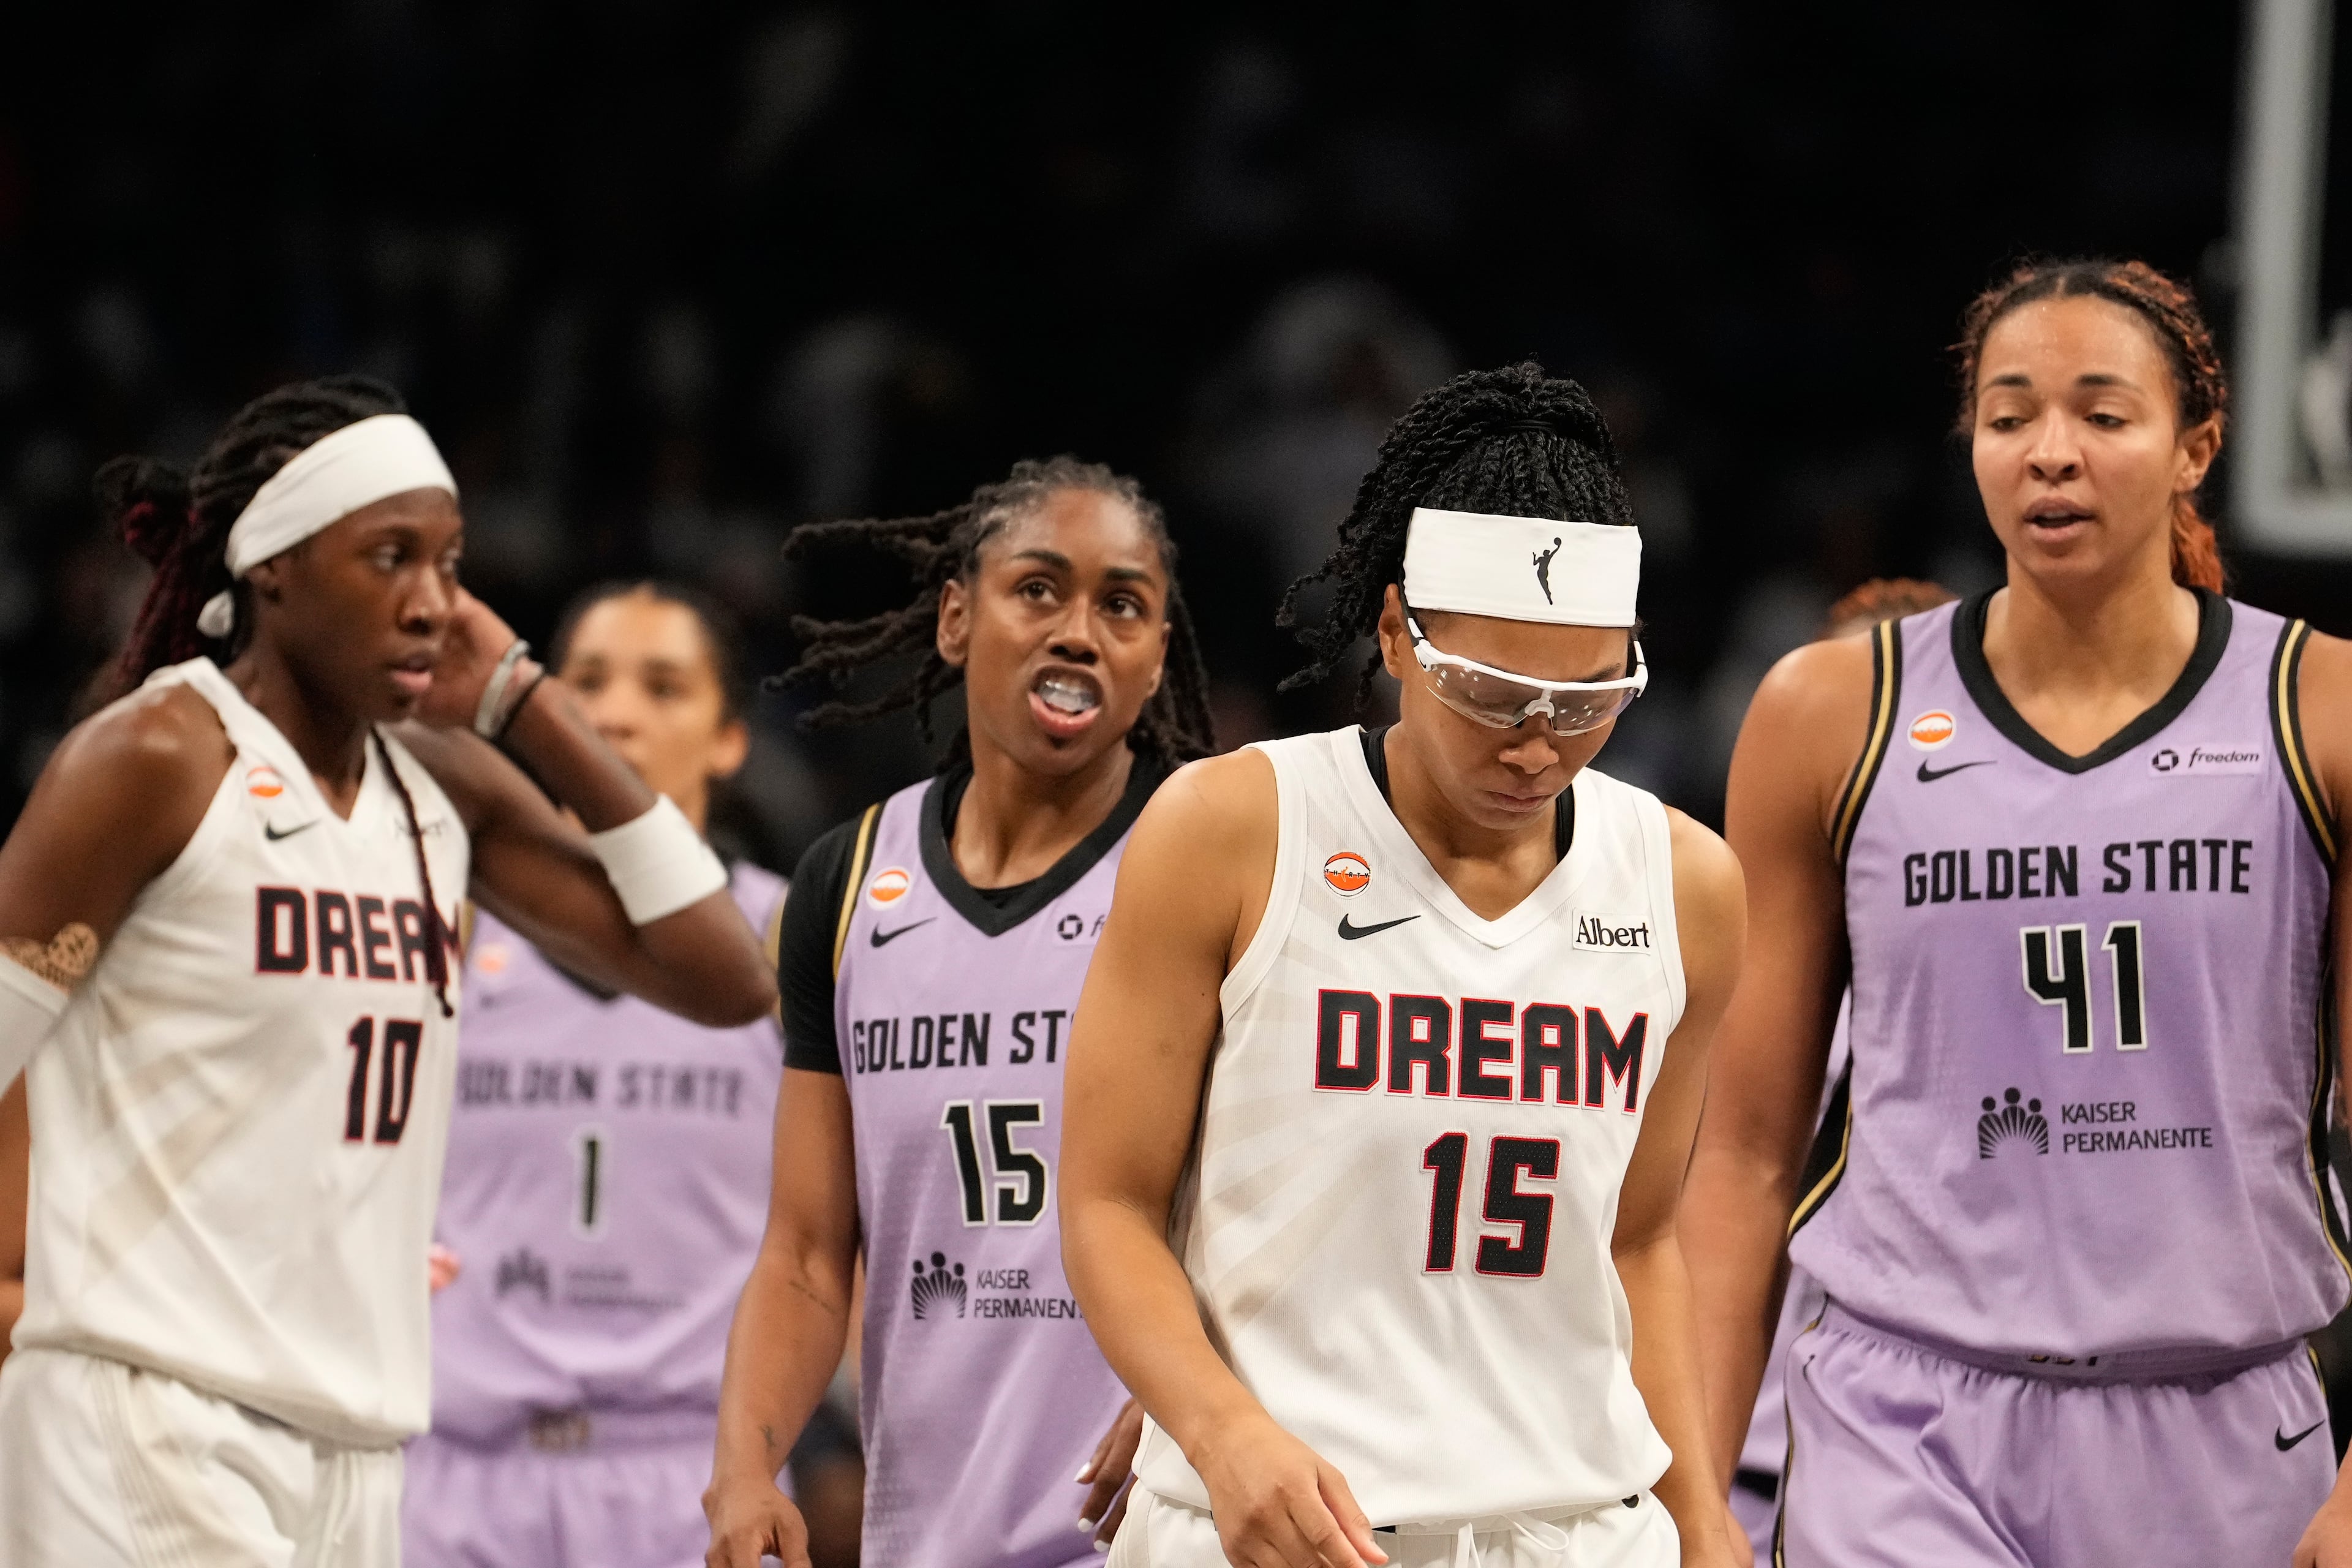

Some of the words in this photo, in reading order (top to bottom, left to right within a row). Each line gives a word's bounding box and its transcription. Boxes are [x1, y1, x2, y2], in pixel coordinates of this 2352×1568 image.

[2188, 746, 2260, 768] freedom
[1903, 845, 2079, 908] GOLDEN
[2102, 839, 2253, 894] STATE
[1575, 914, 1650, 948] Albert
[2019, 920, 2148, 1054] 41
[853, 1012, 990, 1074] GOLDEN
[1009, 1010, 1074, 1064] ST
[1313, 988, 1649, 1114] DREAM
[344, 1015, 423, 1145] 10
[2062, 1101, 2136, 1124] KAISER
[2062, 1127, 2214, 1153] PERMANENTE
[941, 1099, 1049, 1227] 15
[1420, 1131, 1562, 1279] 15
[974, 1297, 1084, 1319] PERMANEN
[976, 1268, 1031, 1289] KAISER
